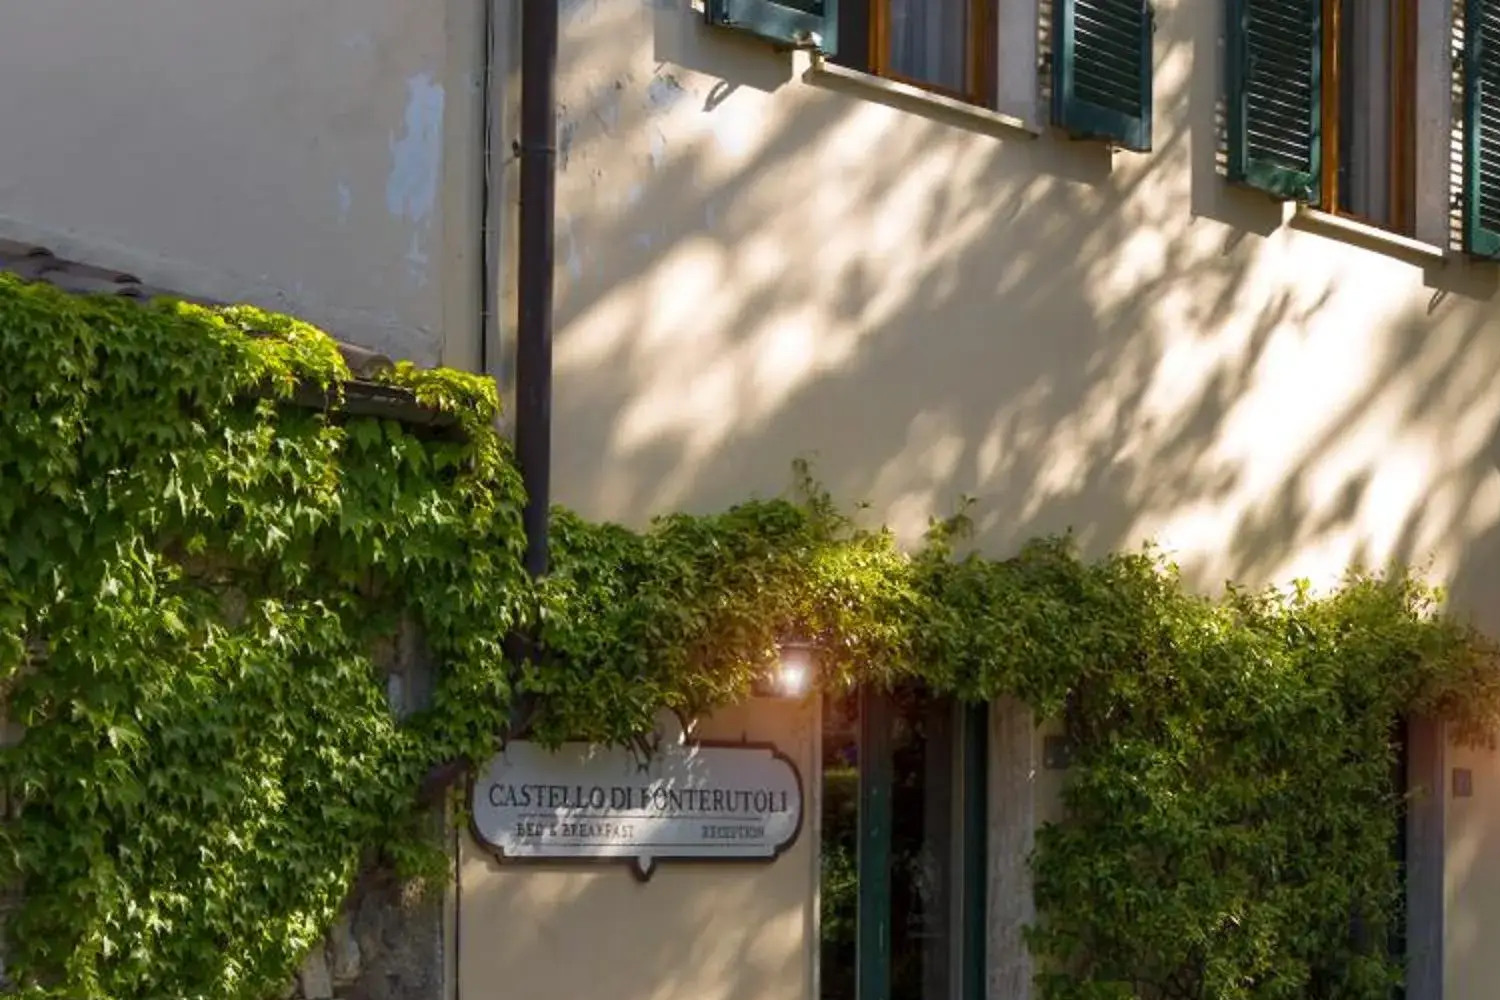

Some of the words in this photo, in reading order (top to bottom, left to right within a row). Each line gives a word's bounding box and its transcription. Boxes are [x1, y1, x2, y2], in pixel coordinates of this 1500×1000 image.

[489, 783, 605, 809] CASTELLO
[611, 786, 632, 809] DI
[640, 787, 788, 813] FONTERUTOLI
